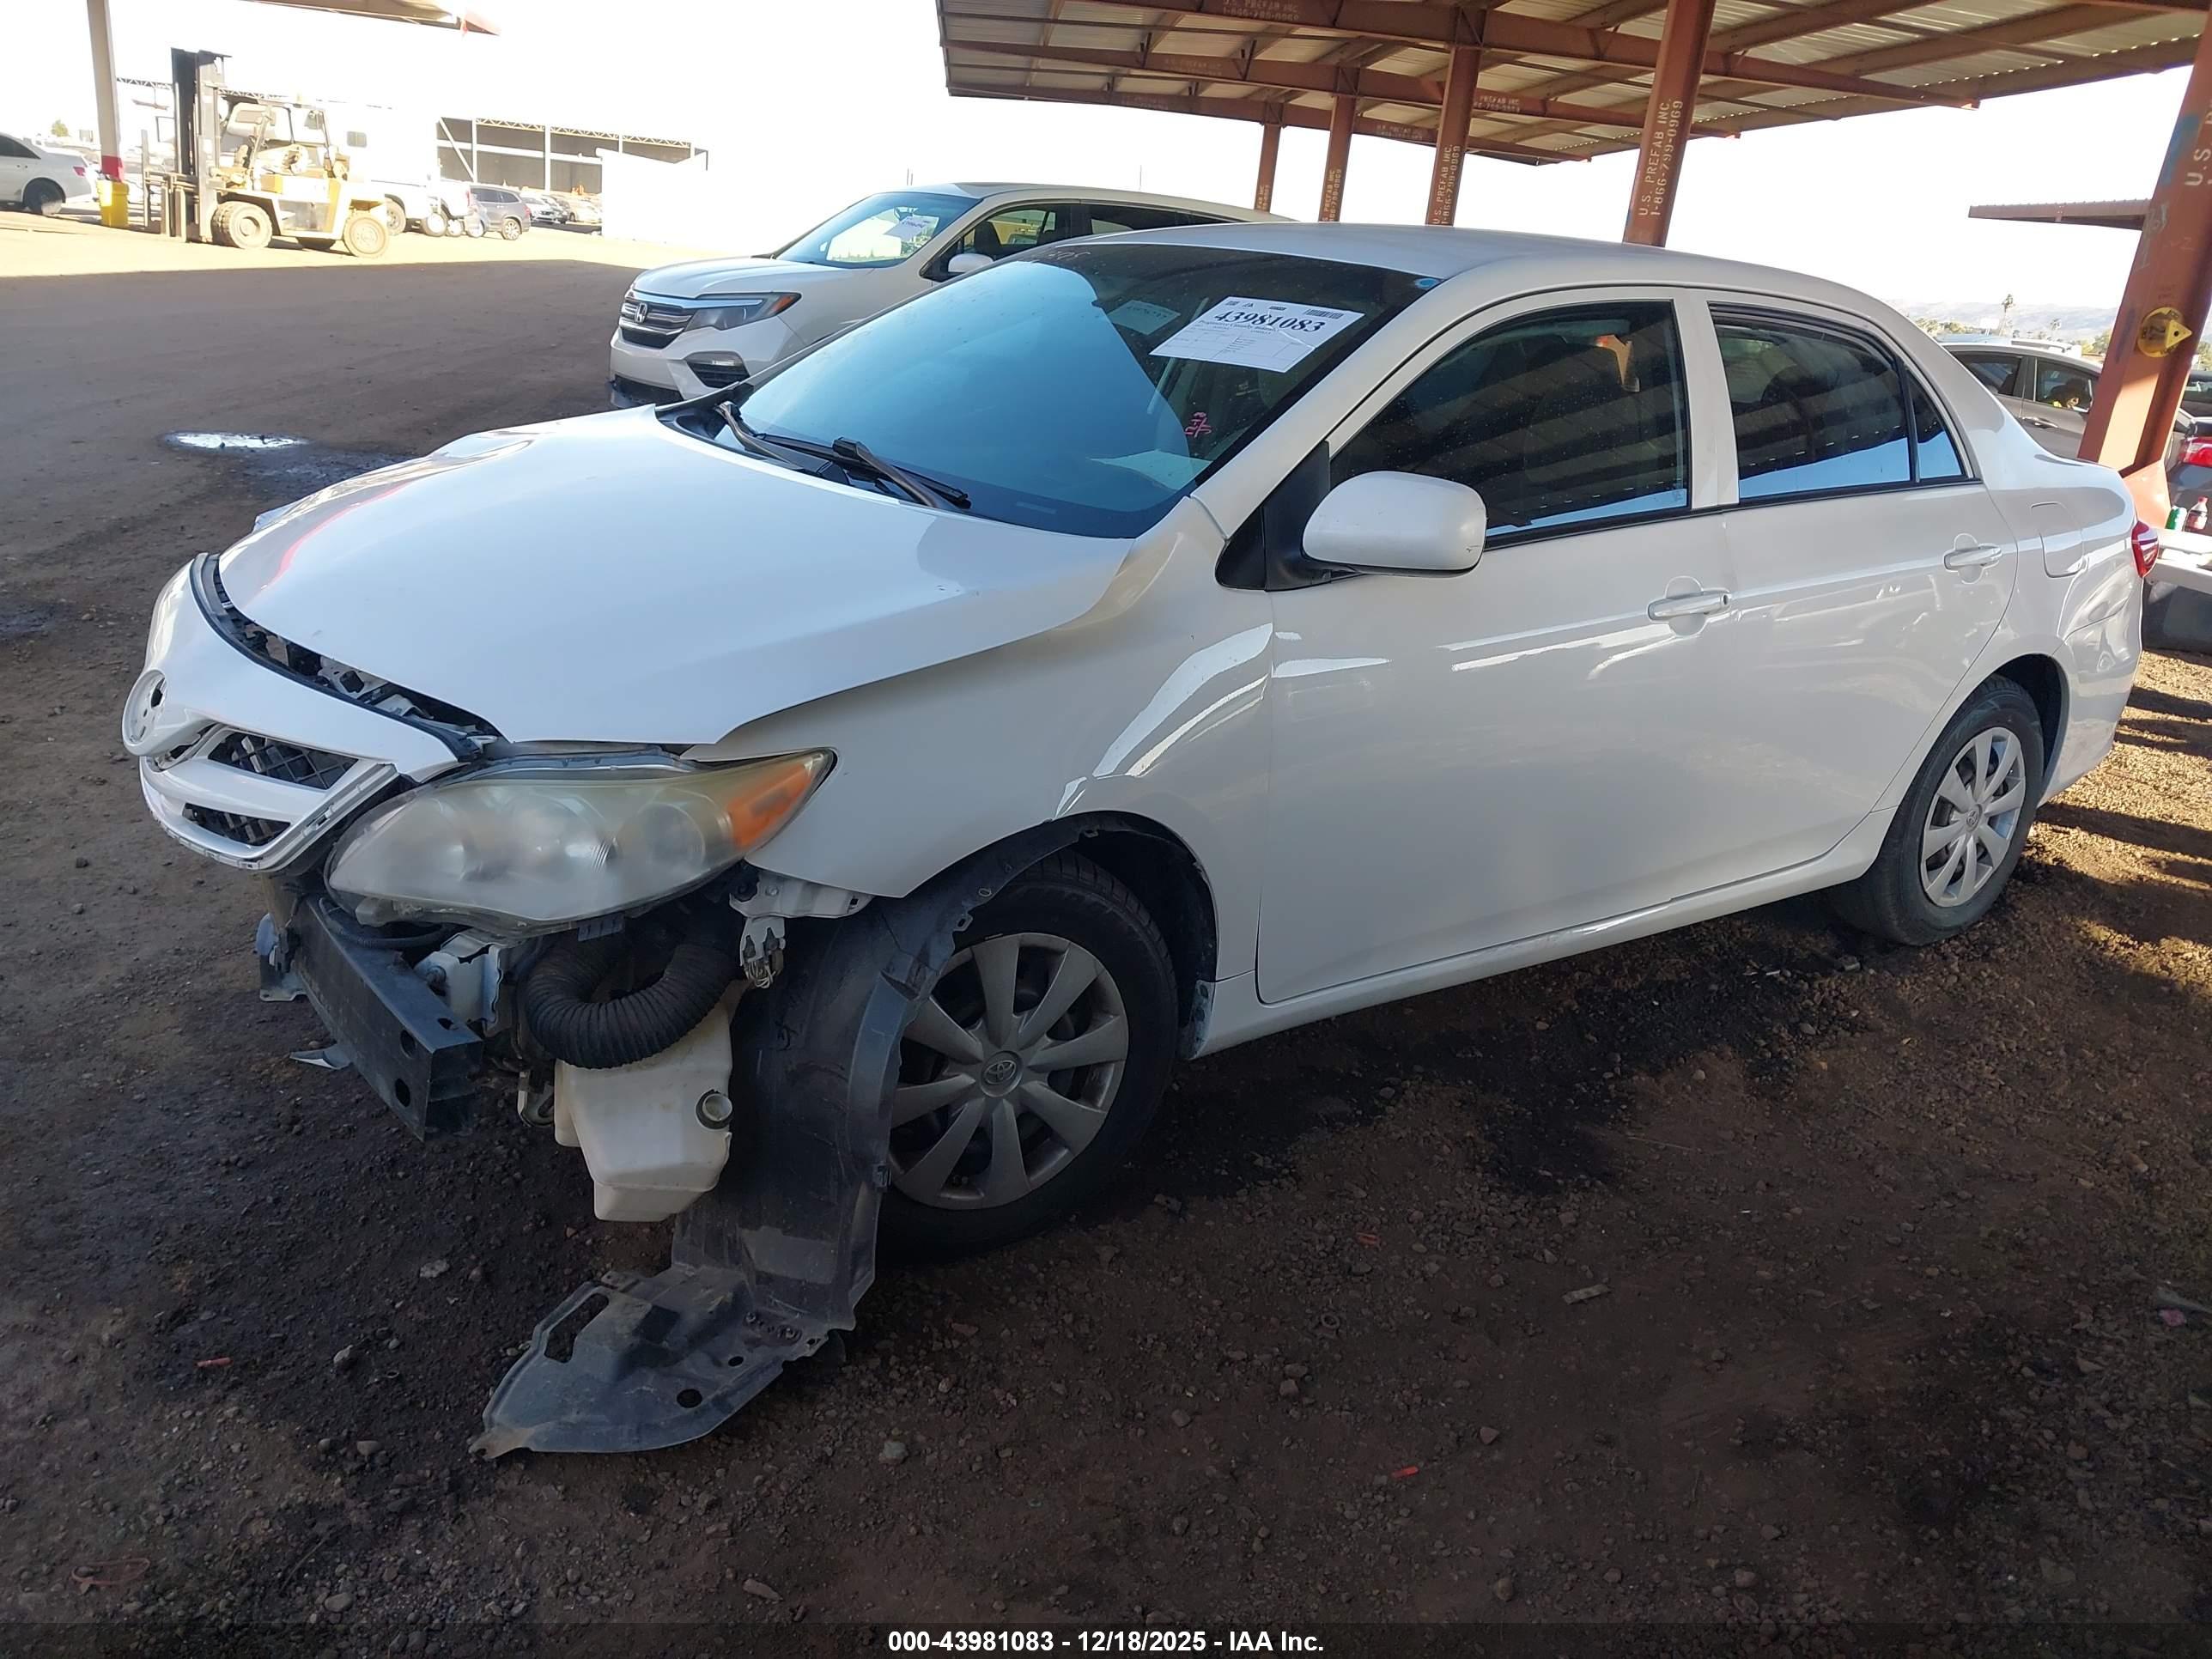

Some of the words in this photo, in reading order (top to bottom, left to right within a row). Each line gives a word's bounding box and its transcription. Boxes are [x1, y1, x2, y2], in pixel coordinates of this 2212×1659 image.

[1644, 131, 1664, 184] PREFAB
[1650, 100, 1684, 216] 1-866-799-0969
[1436, 167, 1449, 203] PREFAB
[1638, 191, 1653, 216] U.S.
[1213, 310, 1327, 333] 43981083
